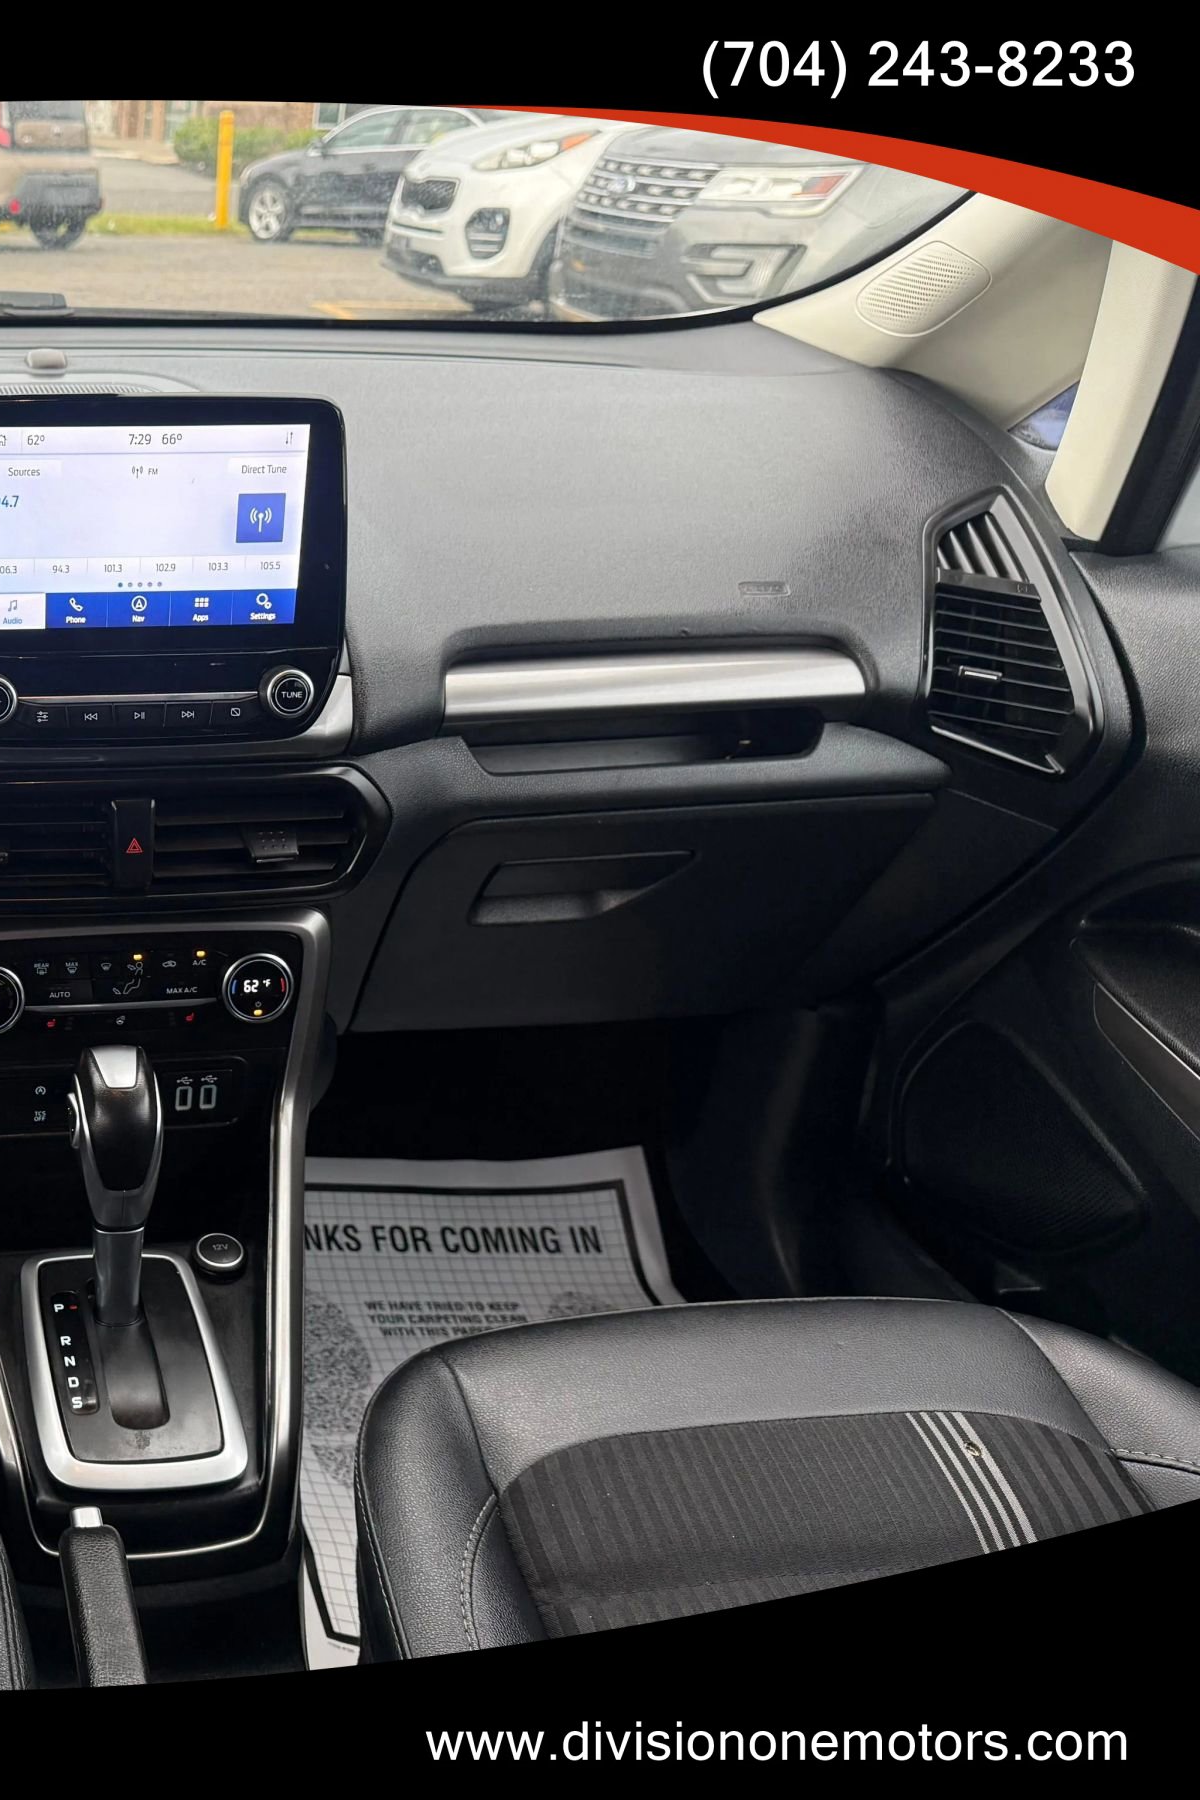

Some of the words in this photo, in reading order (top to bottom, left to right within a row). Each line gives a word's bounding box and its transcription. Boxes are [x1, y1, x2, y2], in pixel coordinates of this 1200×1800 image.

[128, 434, 151, 445] 7:29
[8, 467, 40, 476] Sources
[241, 465, 265, 474] Direct
[267, 465, 287, 474] Tune
[52, 565, 70, 574] 94.3
[104, 564, 122, 573] 101.3
[156, 563, 176, 572] 102.9
[208, 562, 228, 571] 103.3
[260, 561, 280, 570] 105.5
[3, 617, 23, 625] Audio
[66, 616, 86, 624] Phone
[132, 615, 146, 623] Nav
[193, 614, 209, 622] Apps
[250, 612, 276, 621] Settings
[281, 691, 303, 699] TUNE
[243, 980, 259, 993] 62
[303, 1223, 362, 1252] NKS
[371, 1224, 432, 1253] FOR
[440, 1225, 563, 1255] COMING
[567, 1225, 603, 1255] IN
[54, 1304, 64, 1312] P
[365, 1301, 386, 1311] WE
[388, 1301, 422, 1311] HAVE
[426, 1301, 465, 1311] TRIED
[467, 1301, 485, 1311] TO
[486, 1301, 520, 1311] KEEP
[368, 1314, 406, 1324] YOUR
[408, 1314, 482, 1324] CARPETING
[484, 1314, 528, 1324] CLEAN
[380, 1327, 419, 1337] WITH
[420, 1327, 449, 1337] THIS
[60, 1336, 72, 1346] R
[64, 1356, 76, 1367] N
[68, 1377, 79, 1388] D
[72, 1397, 83, 1409] S
